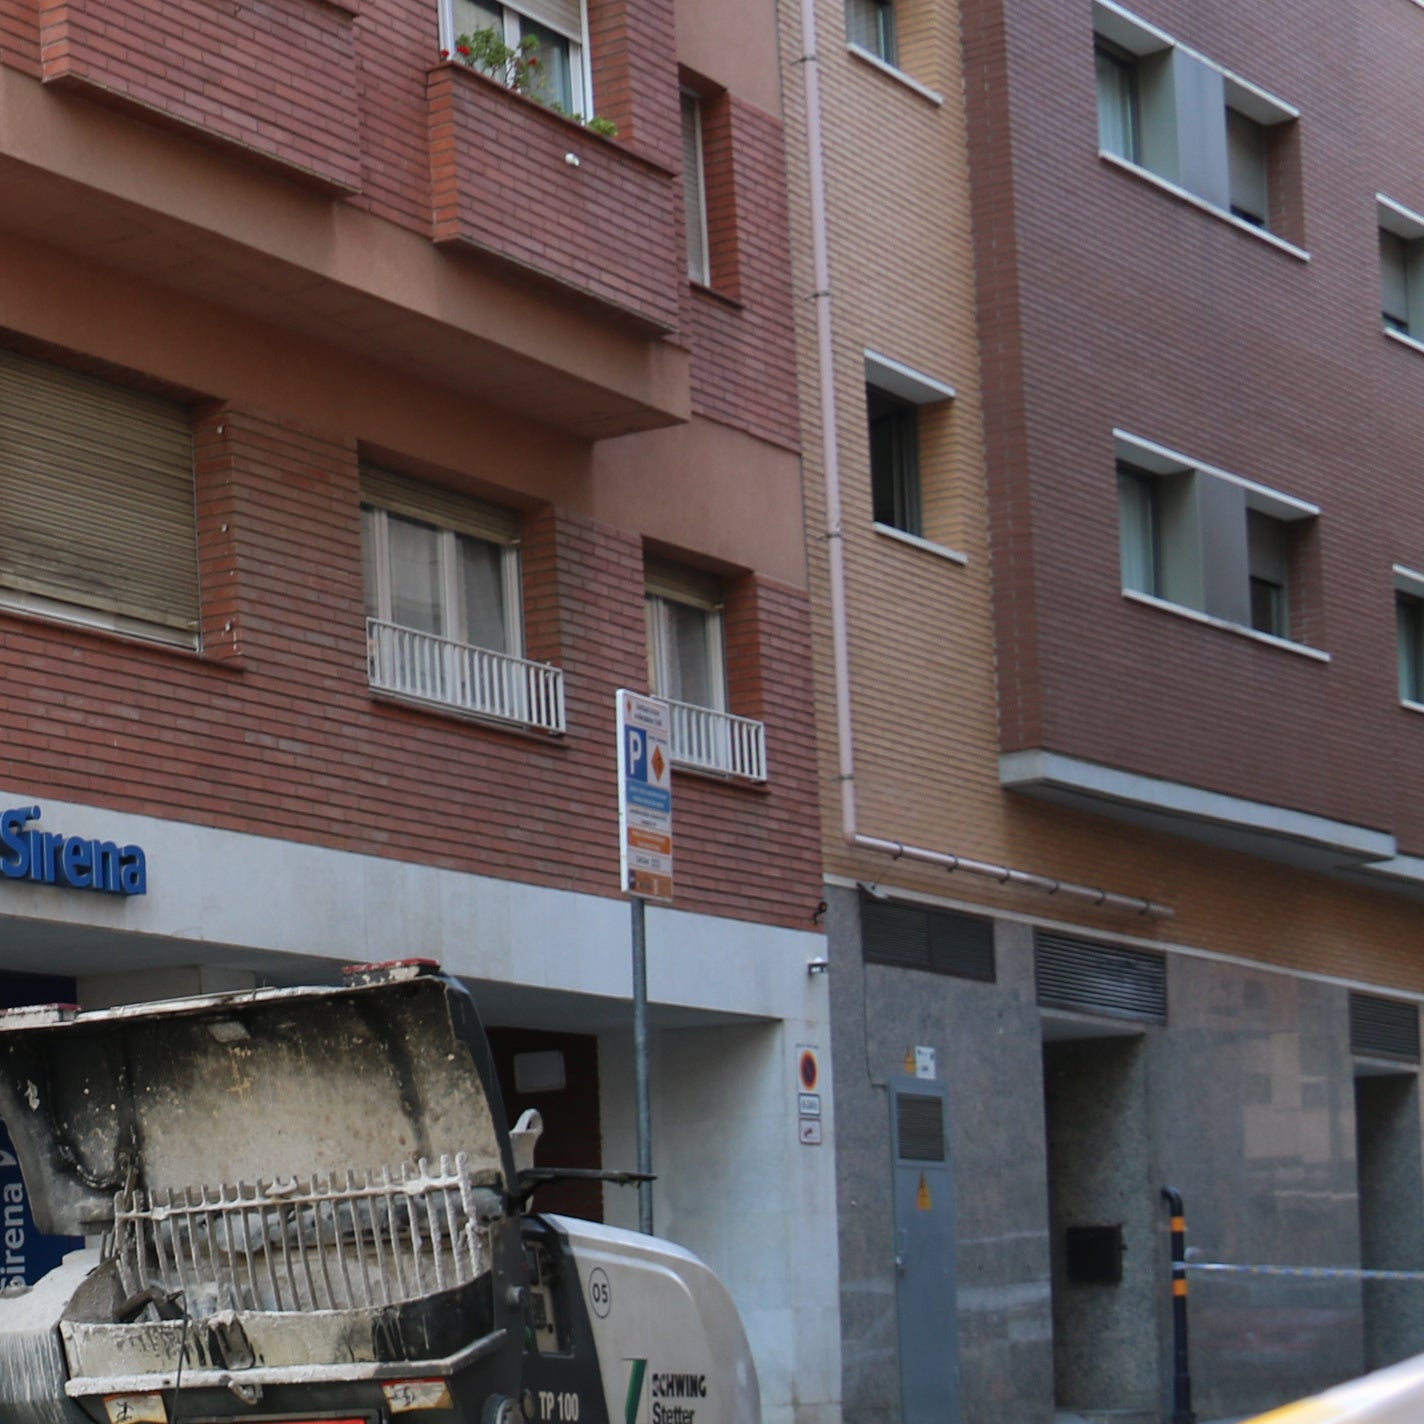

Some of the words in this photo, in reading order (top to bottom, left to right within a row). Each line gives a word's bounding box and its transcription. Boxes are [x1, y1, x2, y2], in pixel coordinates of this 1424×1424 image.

[629, 730, 643, 775] P
[592, 1283, 609, 1304] 05
[652, 1373, 707, 1398] SCHWING
[538, 1391, 555, 1420] TP
[557, 1392, 580, 1422] 100
